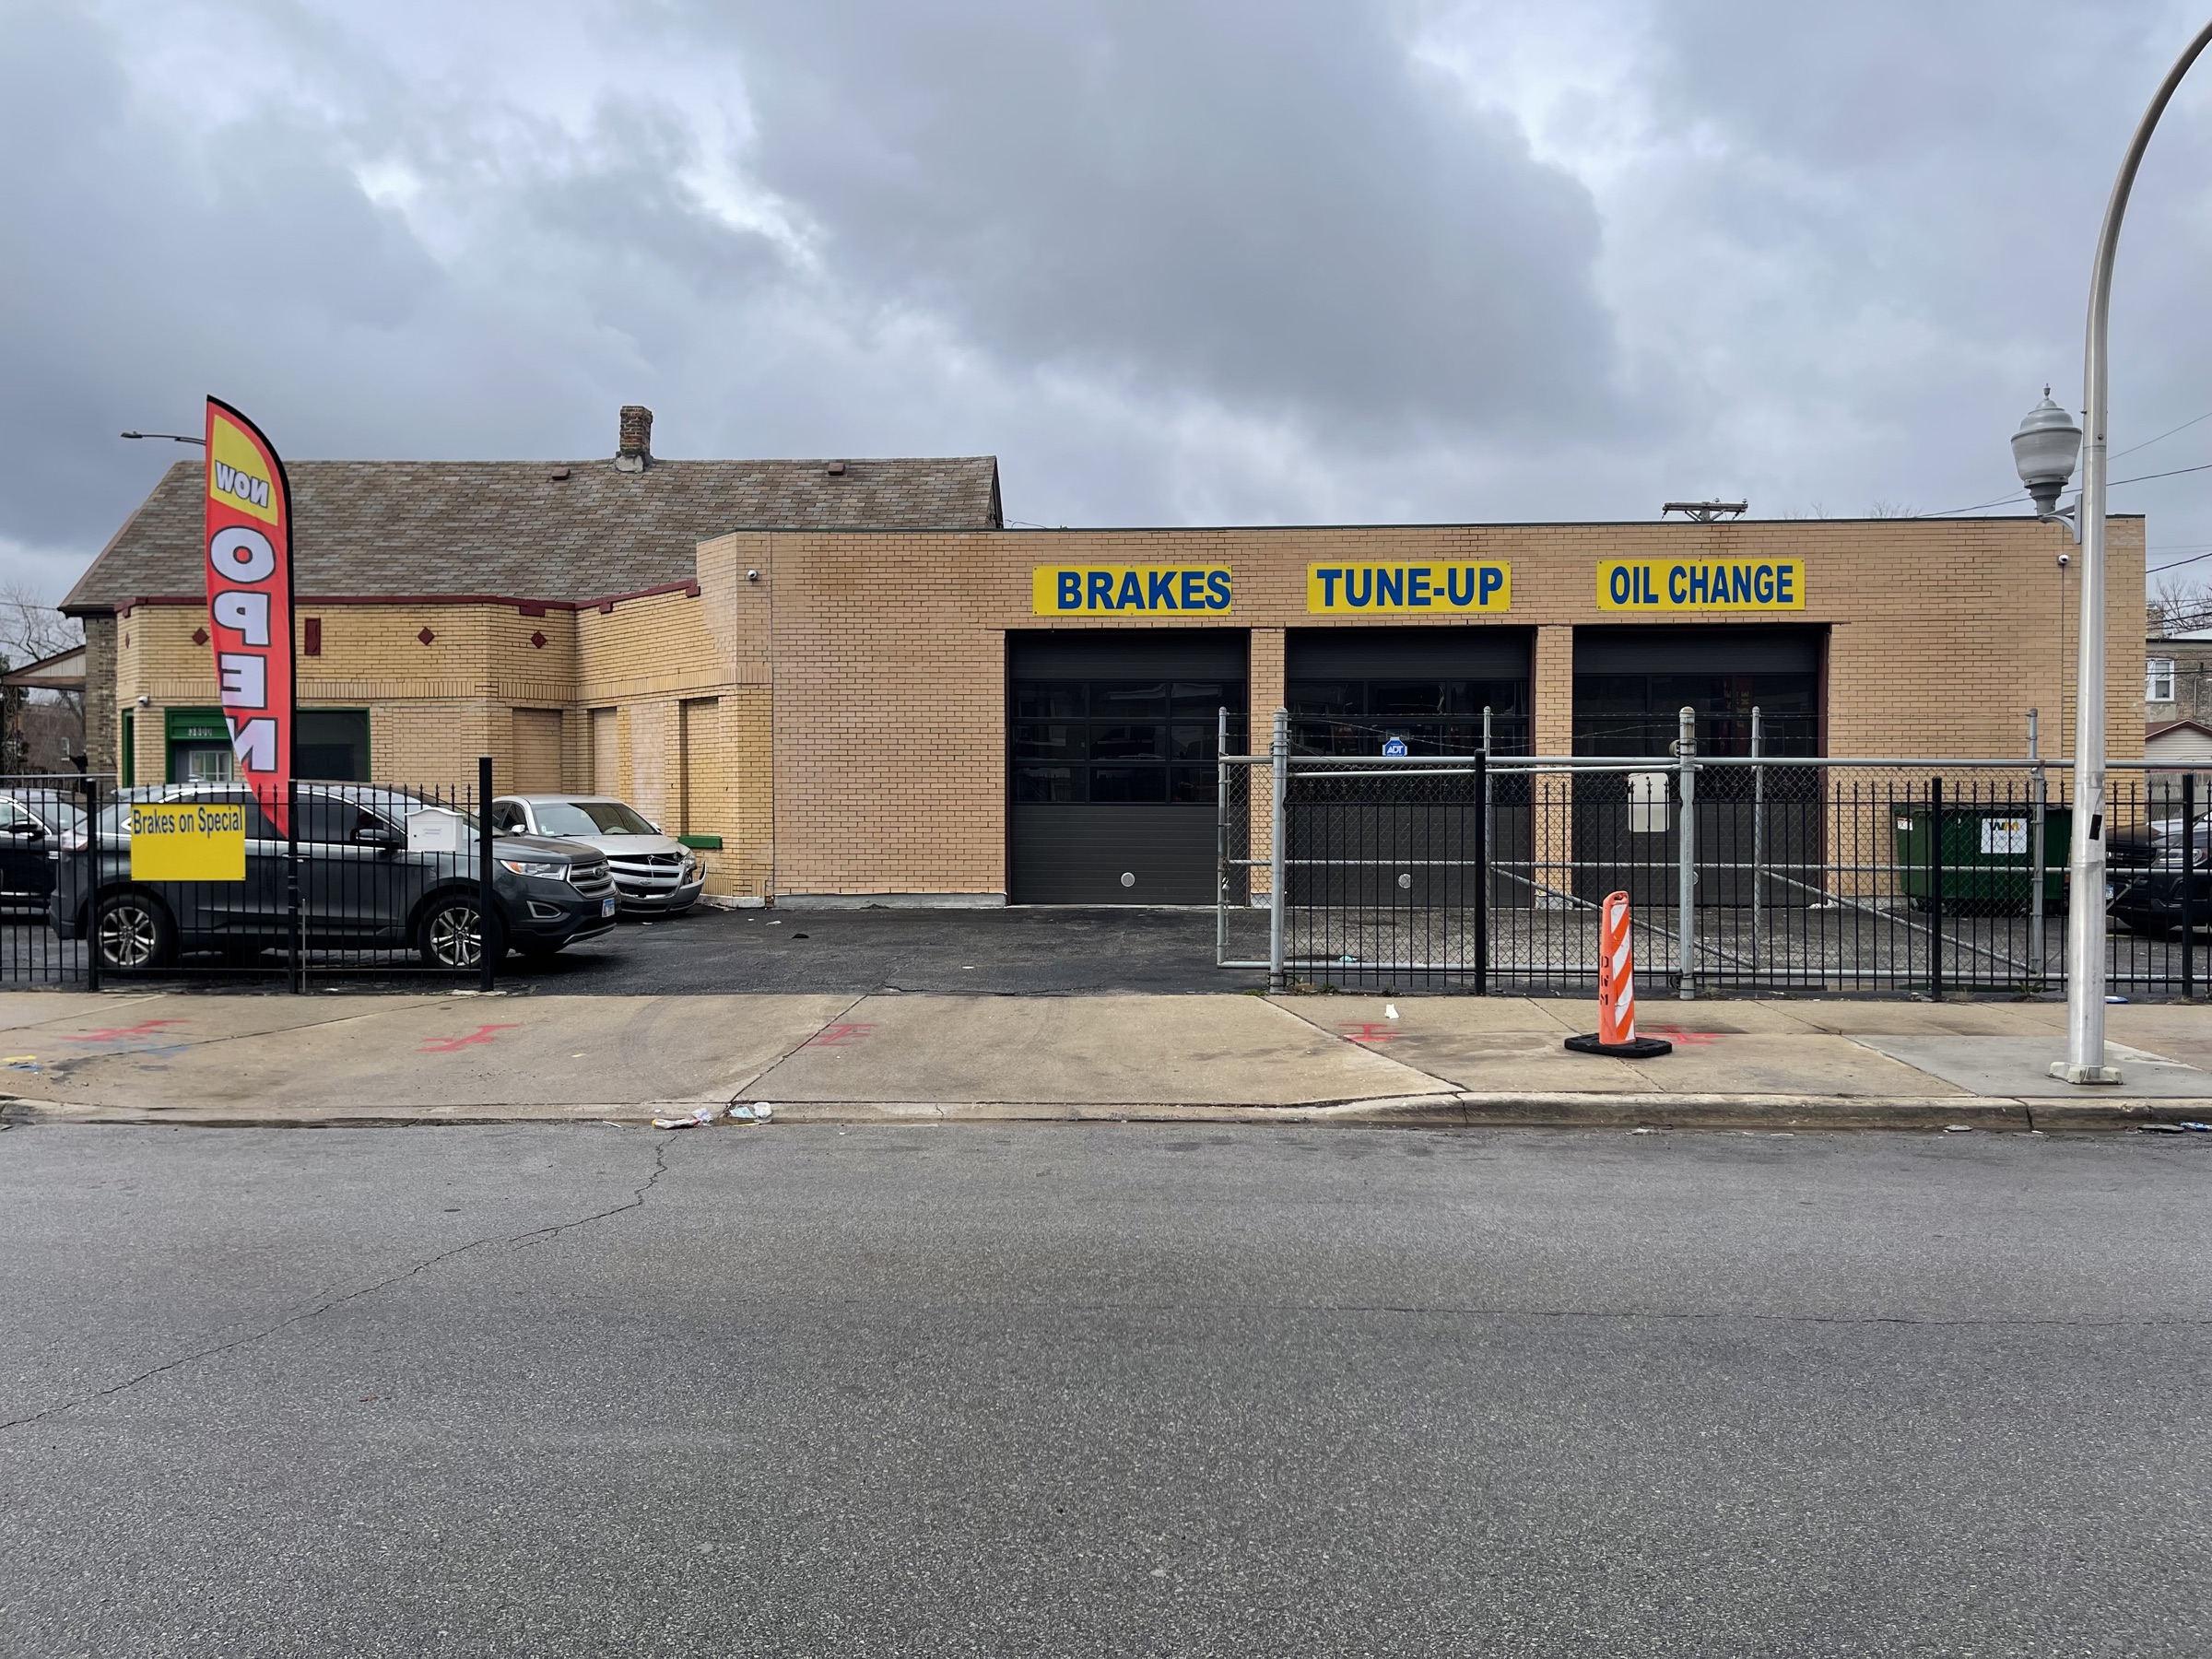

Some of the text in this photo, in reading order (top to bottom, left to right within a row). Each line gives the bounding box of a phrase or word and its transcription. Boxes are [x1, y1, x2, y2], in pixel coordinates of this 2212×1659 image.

[1057, 570, 1232, 610] BRAKES
[1316, 566, 1504, 608] TUNE-UP
[1609, 564, 1794, 606] OIL CHANGE
[1386, 745, 1404, 754] ADT
[133, 805, 242, 839] Brakes on Special
